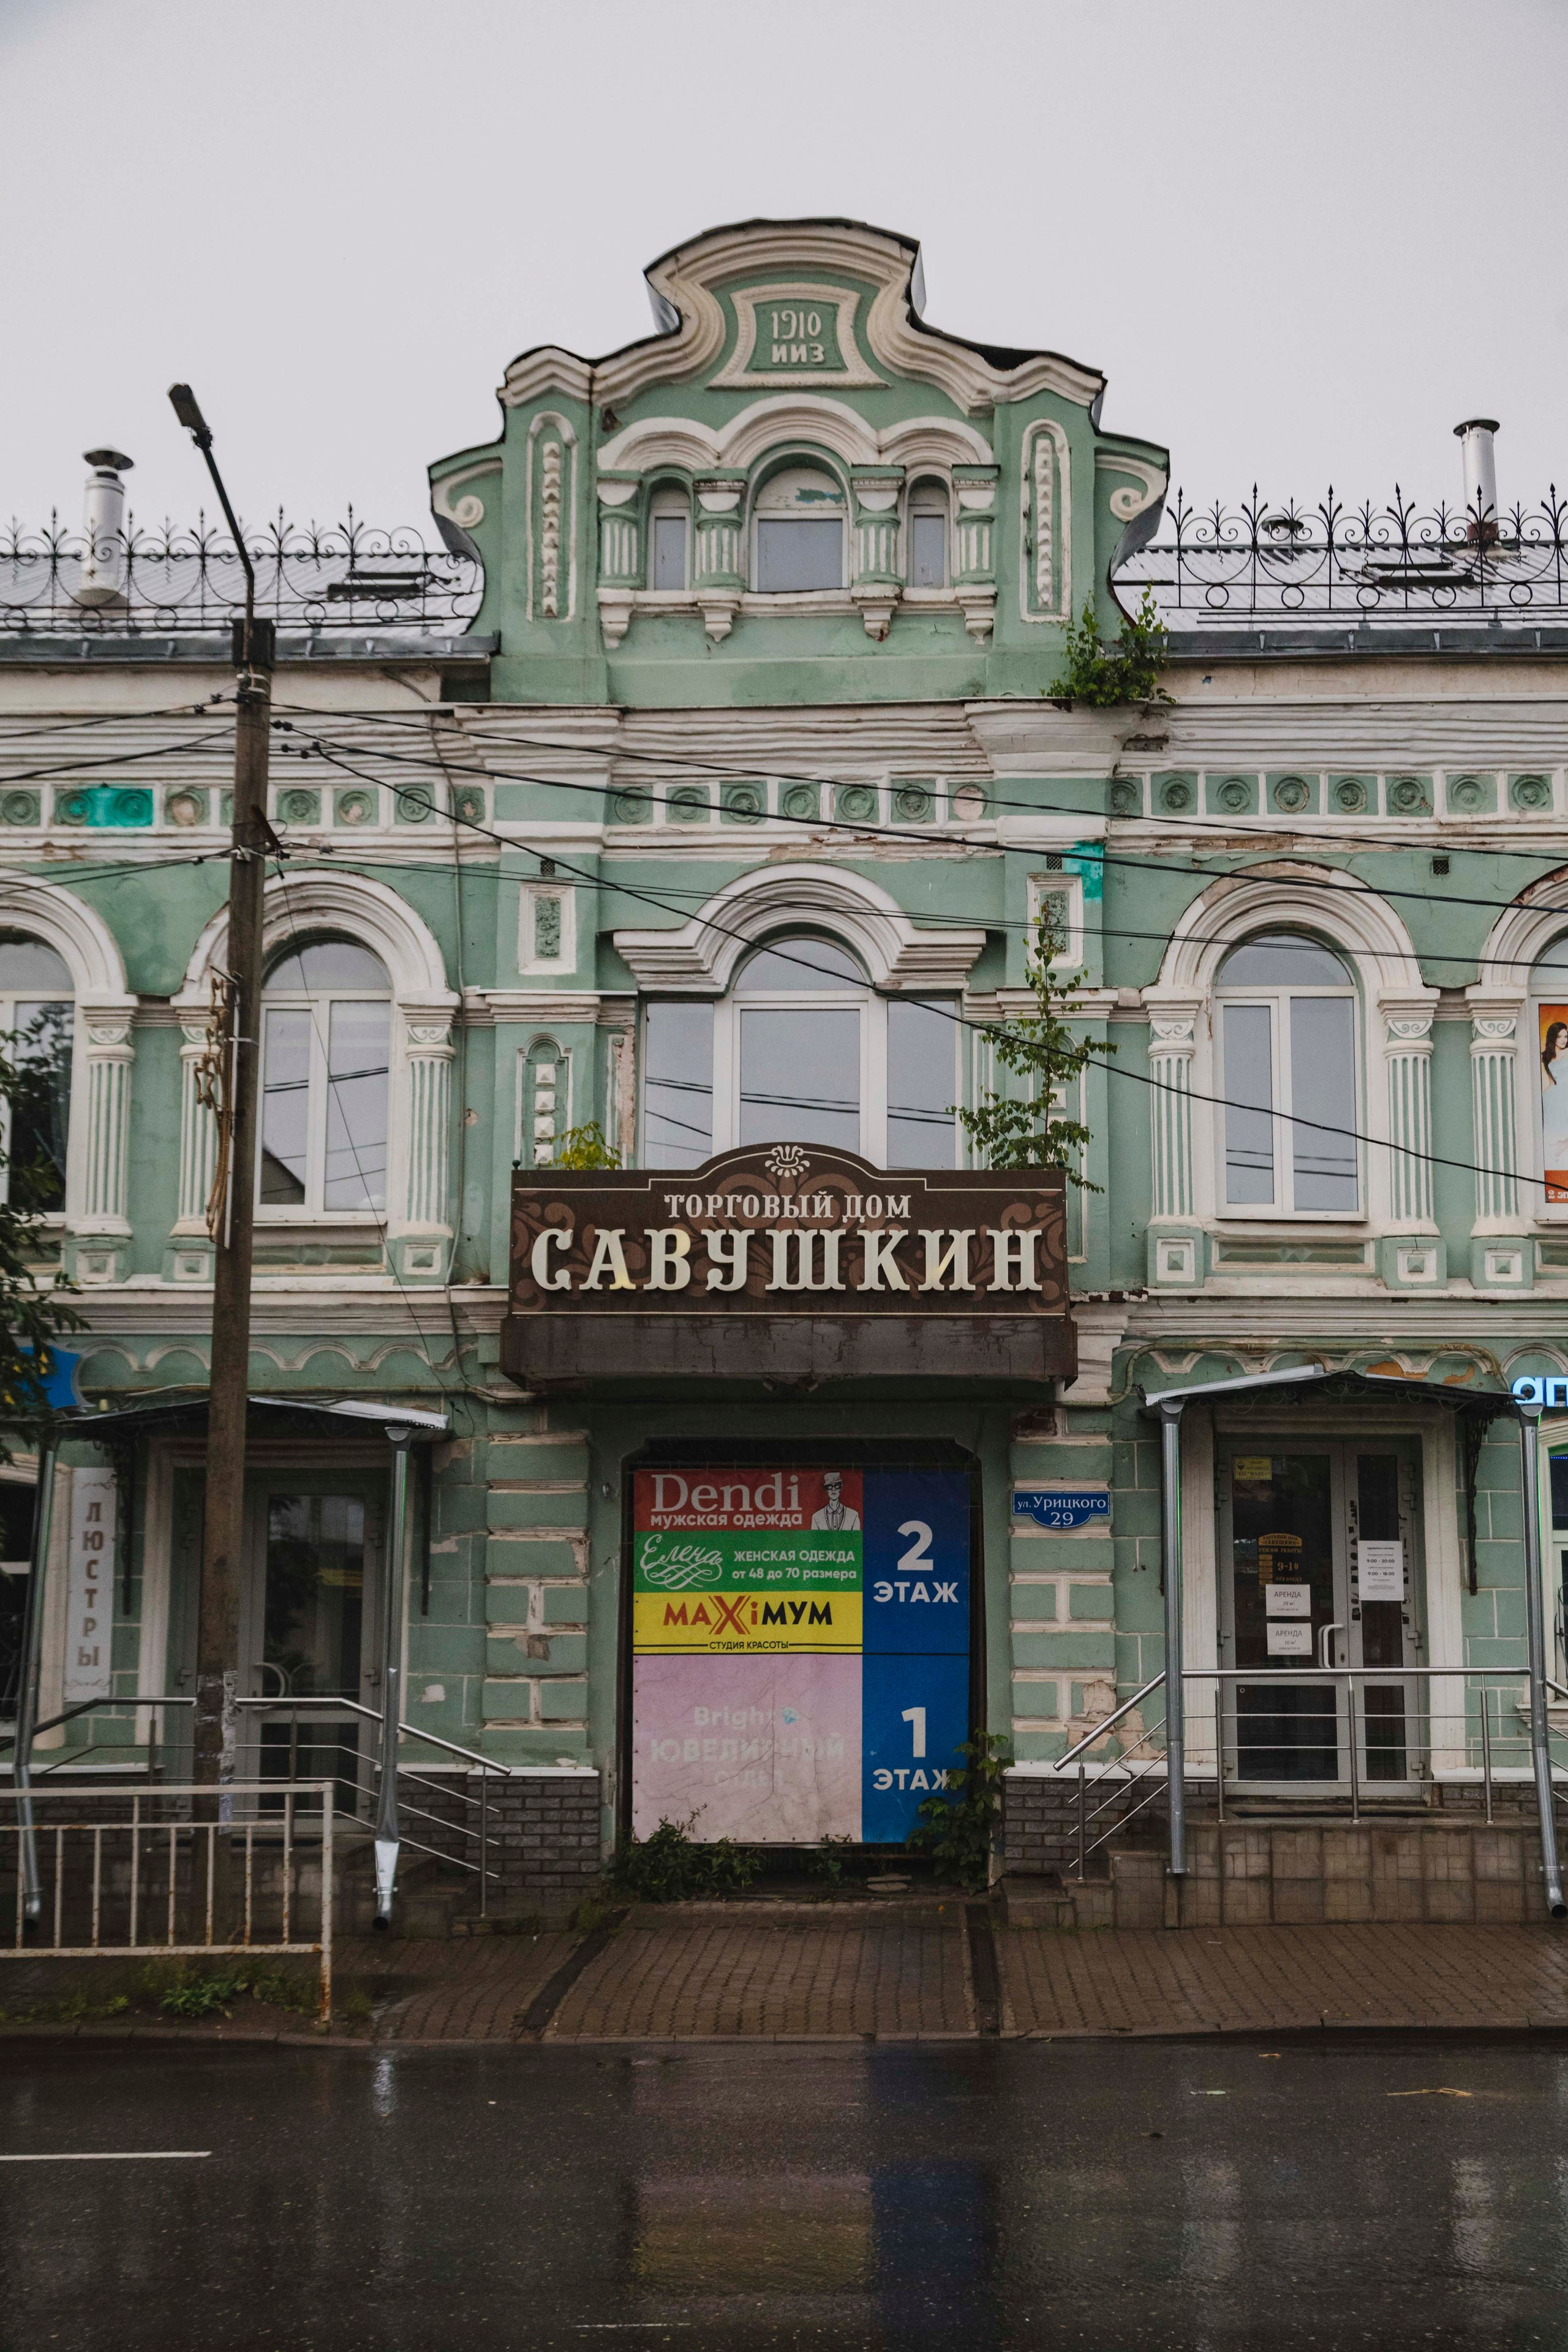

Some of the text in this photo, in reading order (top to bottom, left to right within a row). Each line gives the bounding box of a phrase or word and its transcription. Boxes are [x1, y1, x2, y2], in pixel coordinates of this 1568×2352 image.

[771, 310, 821, 339] 1910
[663, 1189, 911, 1223] ТОРГОВЫЙ ДОМ
[1548, 1189, 1555, 1199] 2
[530, 1227, 1043, 1292] САВУШКИН
[650, 1472, 802, 1512] Dendi
[1017, 1496, 1106, 1511] ул. Урицкого
[650, 1512, 802, 1529] мужская одежда
[1050, 1512, 1074, 1525] 29
[734, 1550, 855, 1562] ЖЕНСКАЯ ОДЕЖДА
[897, 1520, 934, 1571] 2
[640, 1534, 724, 1590] Елена
[732, 1567, 856, 1581] от 48 до 70 размера
[77, 1502, 105, 1667] ЛЮСТРЫ
[873, 1580, 959, 1604] ЭТАЖ
[709, 1641, 788, 1650] СТУДИЯ КРАСОТЫ
[901, 1706, 926, 1758] 1
[651, 1732, 844, 1762] ЮВЕЛИНЫЙ
